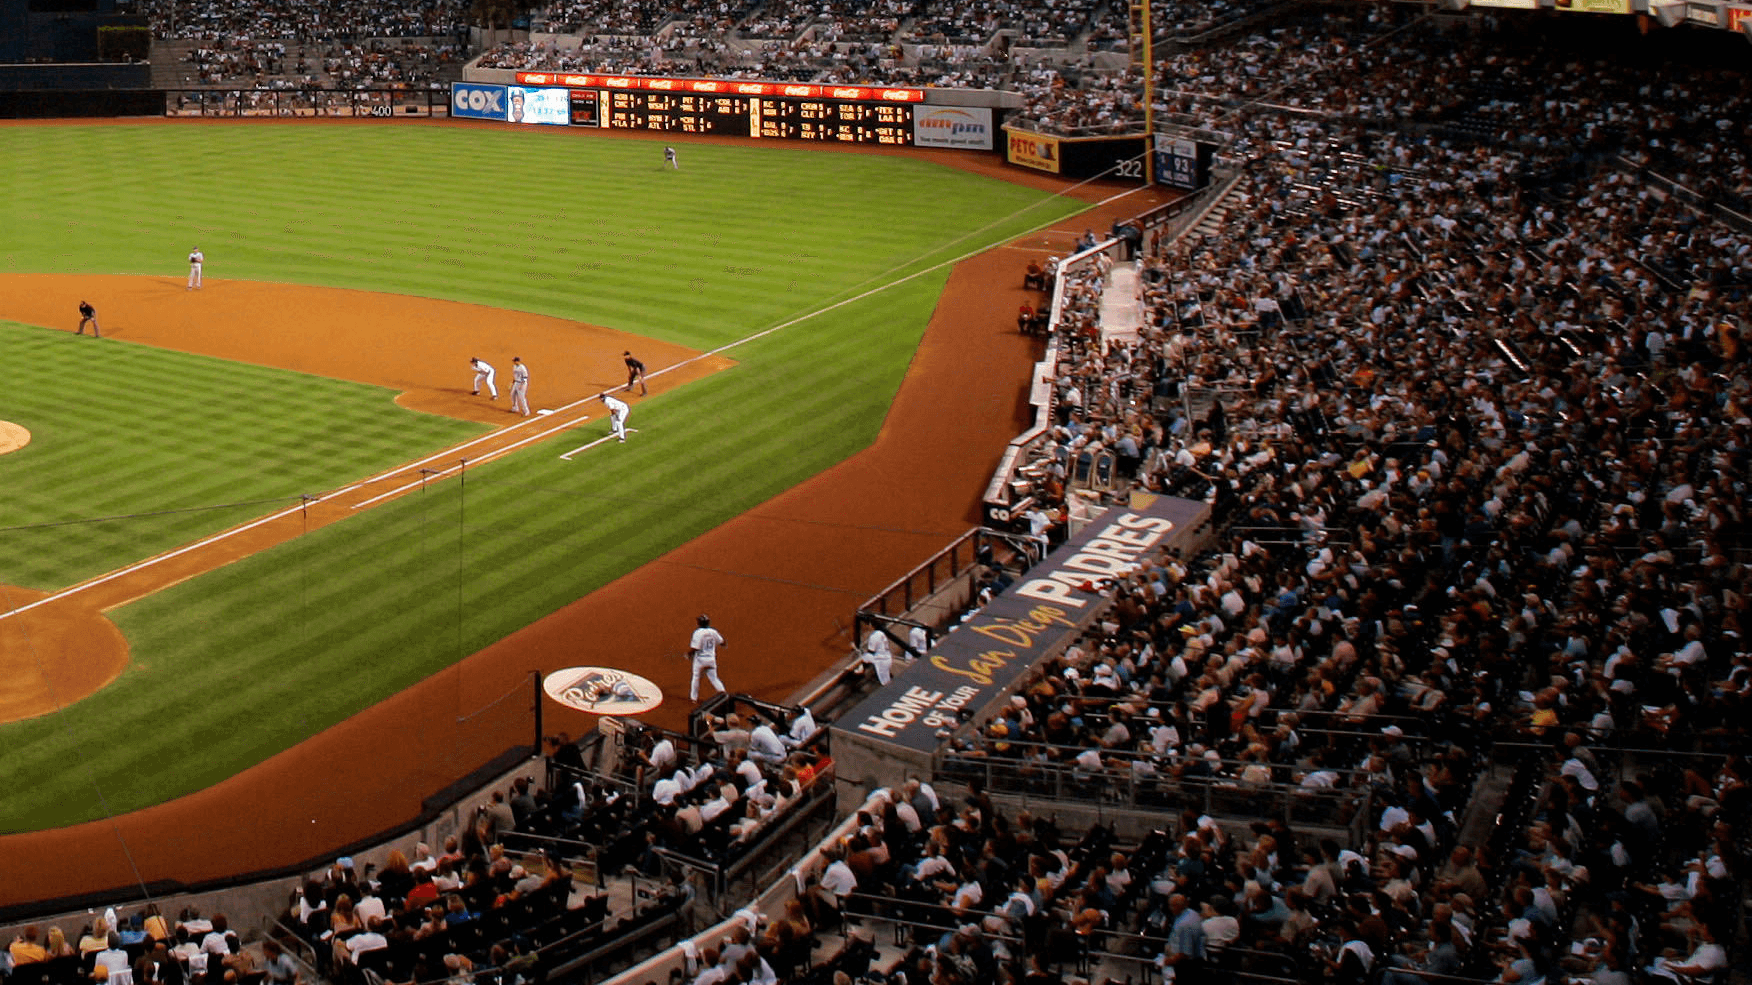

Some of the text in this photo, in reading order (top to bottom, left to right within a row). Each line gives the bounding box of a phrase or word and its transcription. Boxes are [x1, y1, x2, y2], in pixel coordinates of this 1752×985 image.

[373, 105, 391, 116] 400
[456, 90, 503, 113] COX
[1115, 159, 1142, 177] 322
[1016, 512, 1175, 608] PADRES
[930, 605, 1076, 684] San Diego
[563, 669, 624, 709] Padres
[936, 686, 980, 710] YOUR
[858, 685, 944, 738] HOME
